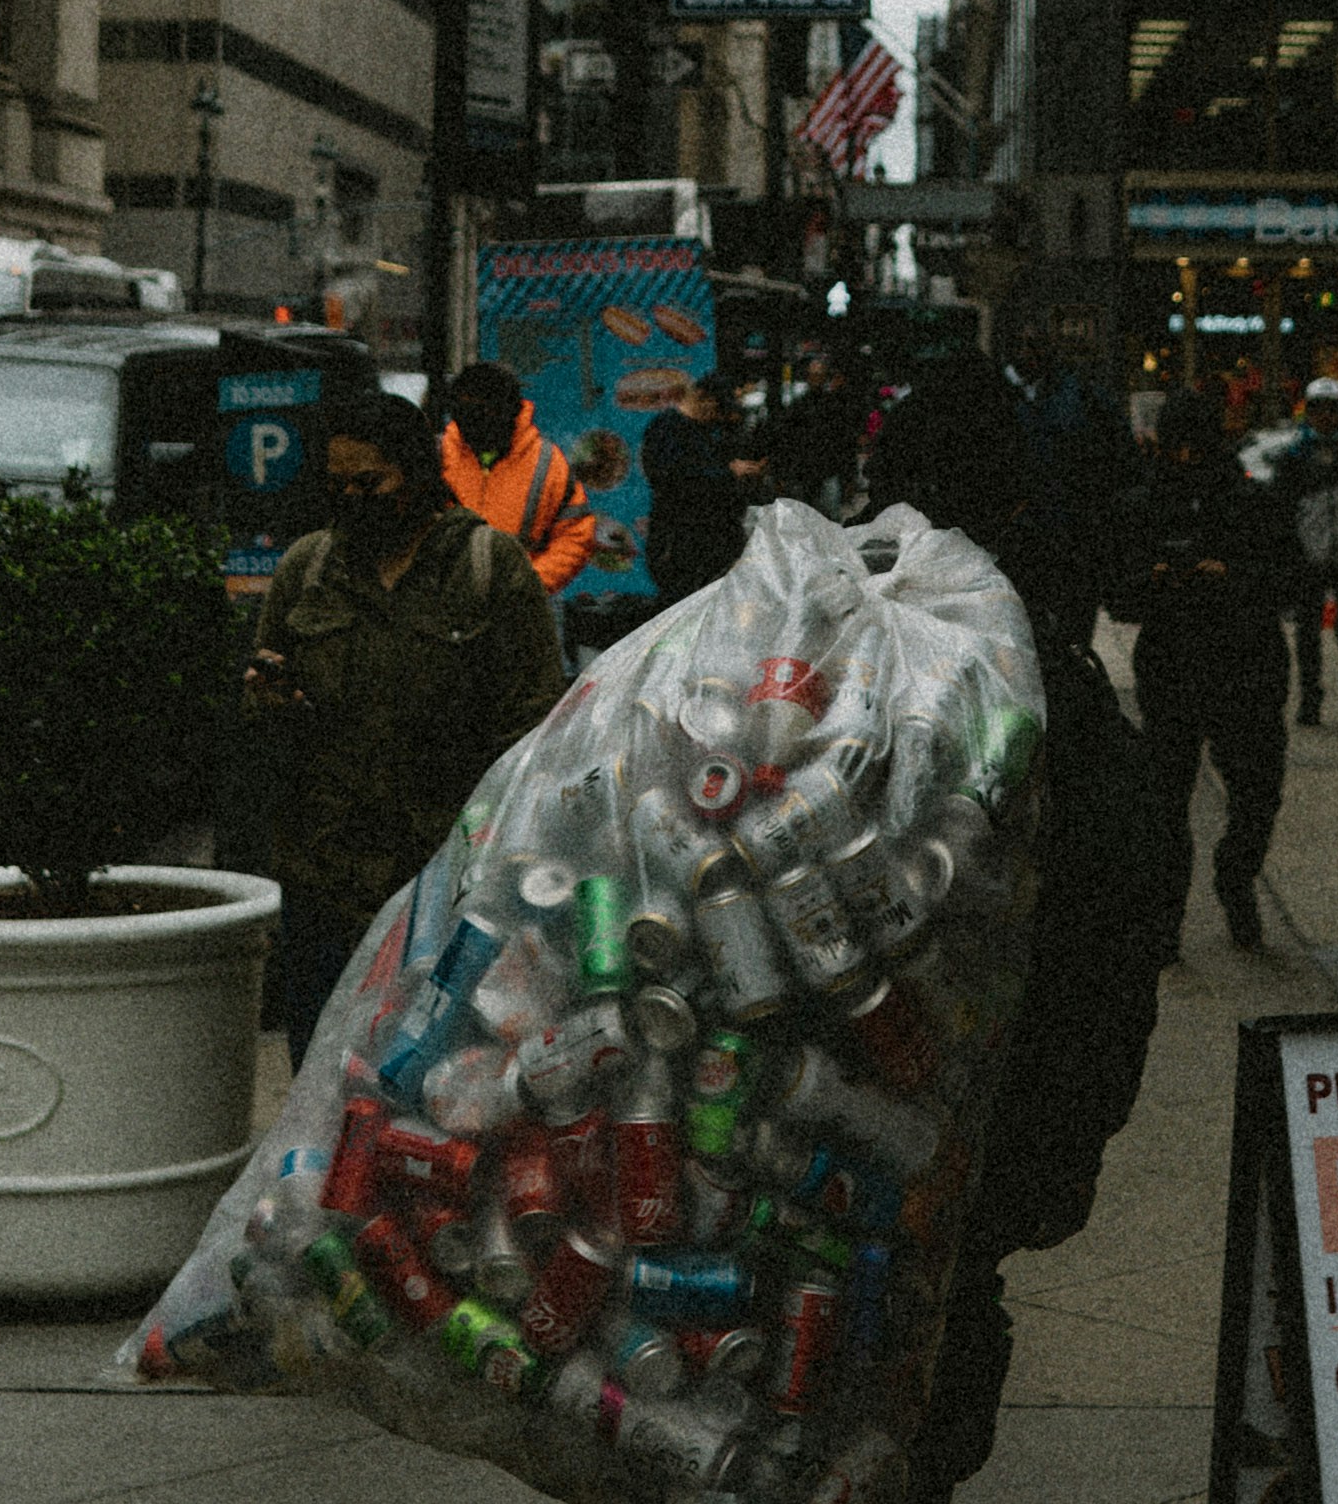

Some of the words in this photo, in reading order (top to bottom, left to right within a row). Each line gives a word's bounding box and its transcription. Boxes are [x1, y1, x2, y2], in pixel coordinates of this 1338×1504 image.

[493, 250, 618, 278] DELICIOUS
[624, 247, 695, 271] FOOD
[249, 422, 291, 486] P
